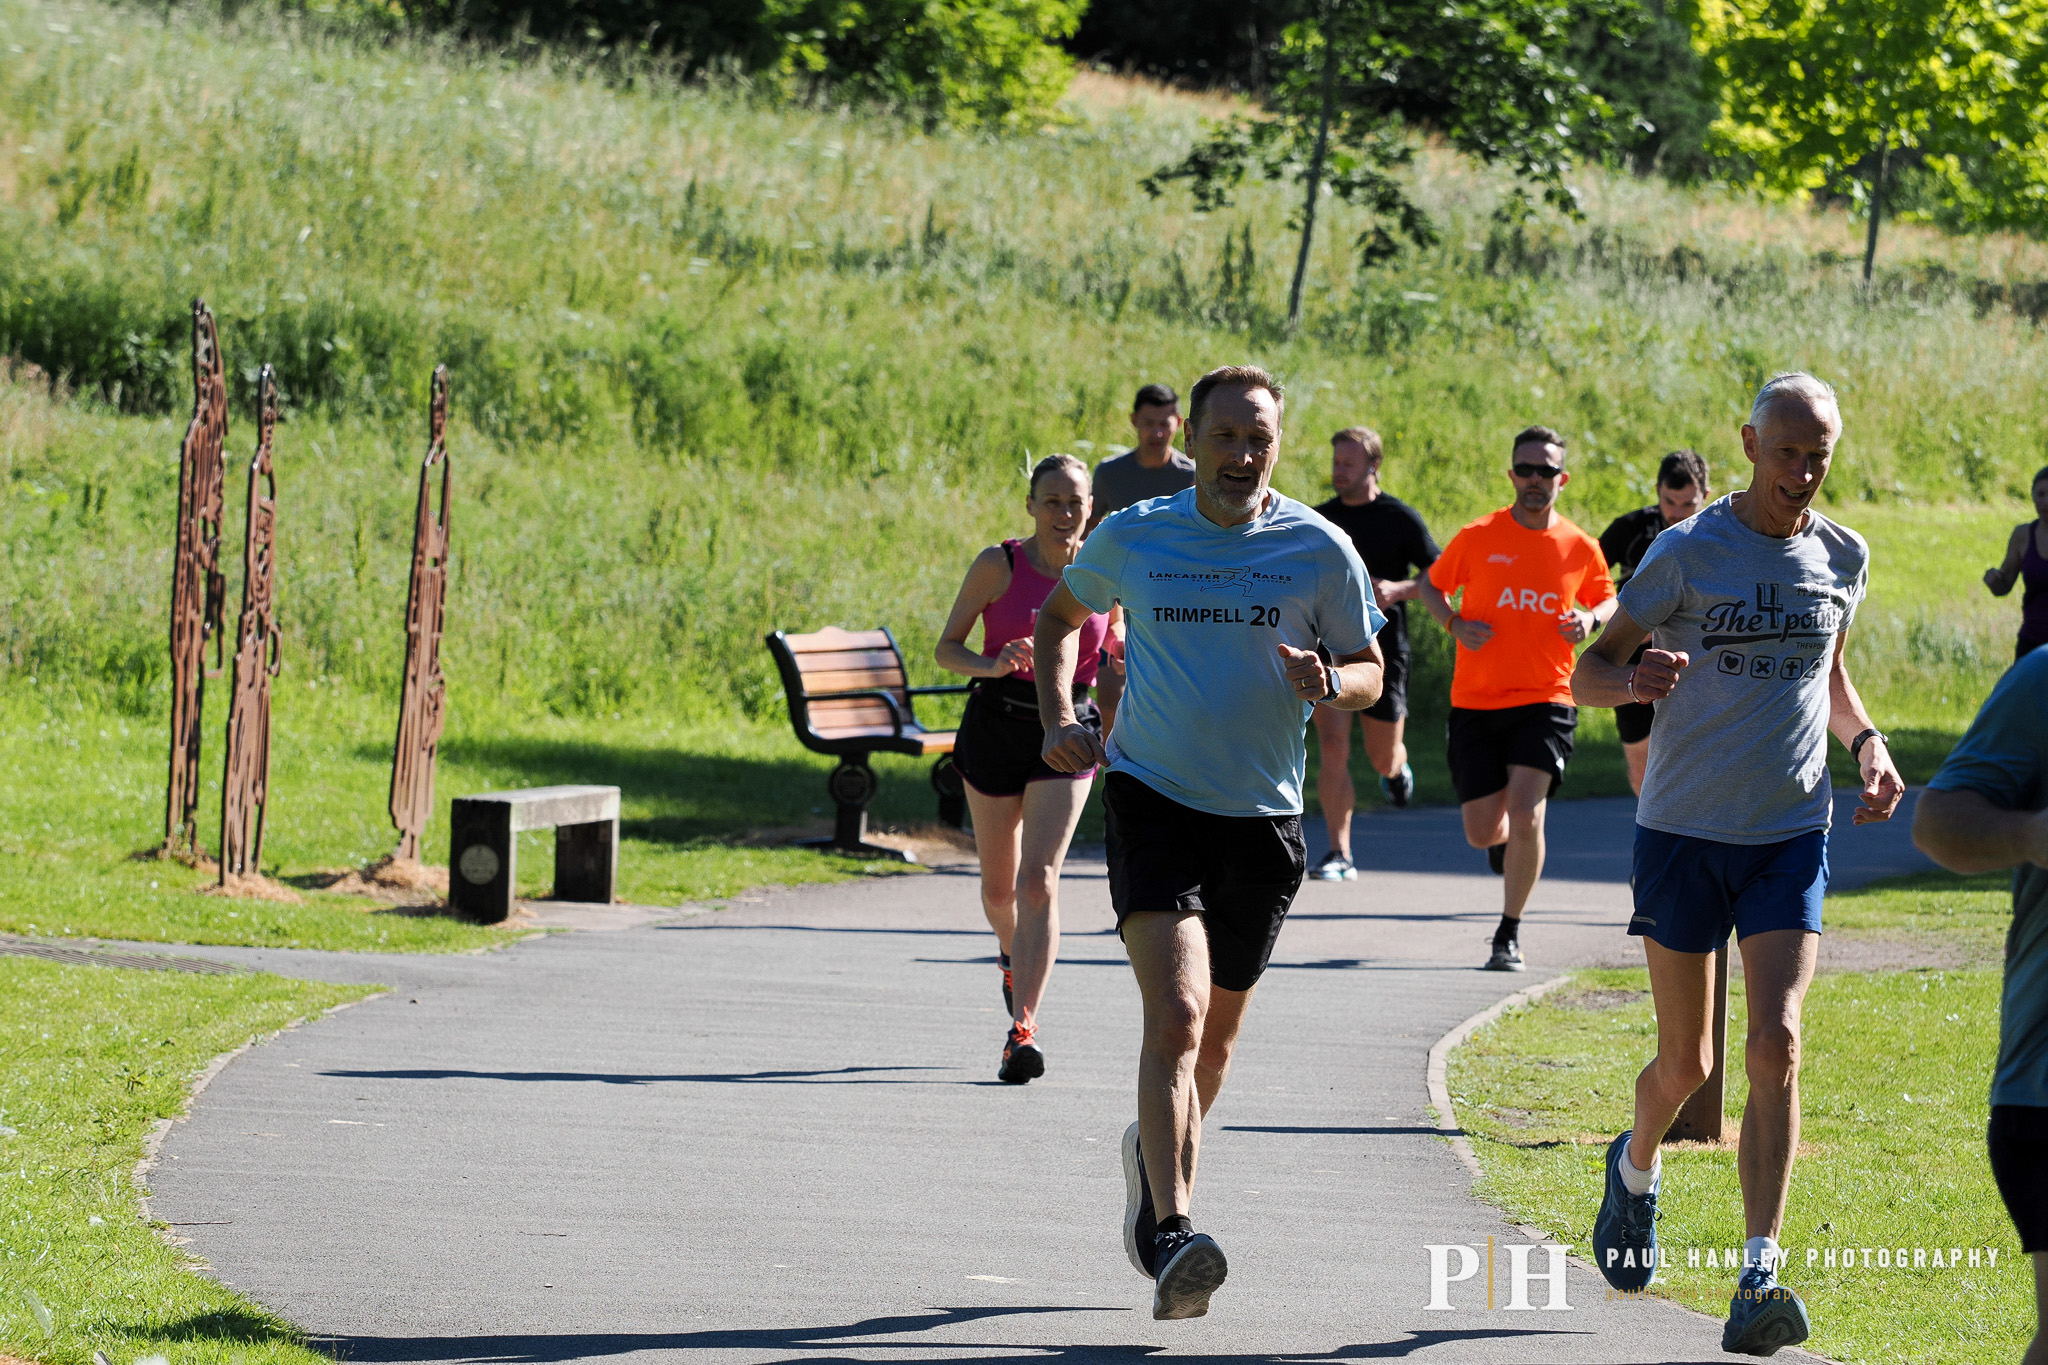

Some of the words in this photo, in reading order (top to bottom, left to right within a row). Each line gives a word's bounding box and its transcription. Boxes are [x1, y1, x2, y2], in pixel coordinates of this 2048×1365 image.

[1149, 571, 1220, 580] LANCASTER
[1252, 572, 1292, 582] RACES
[1496, 586, 1559, 614] ARC
[1153, 607, 1244, 623] TRIMPELL
[1250, 605, 1281, 628] 20
